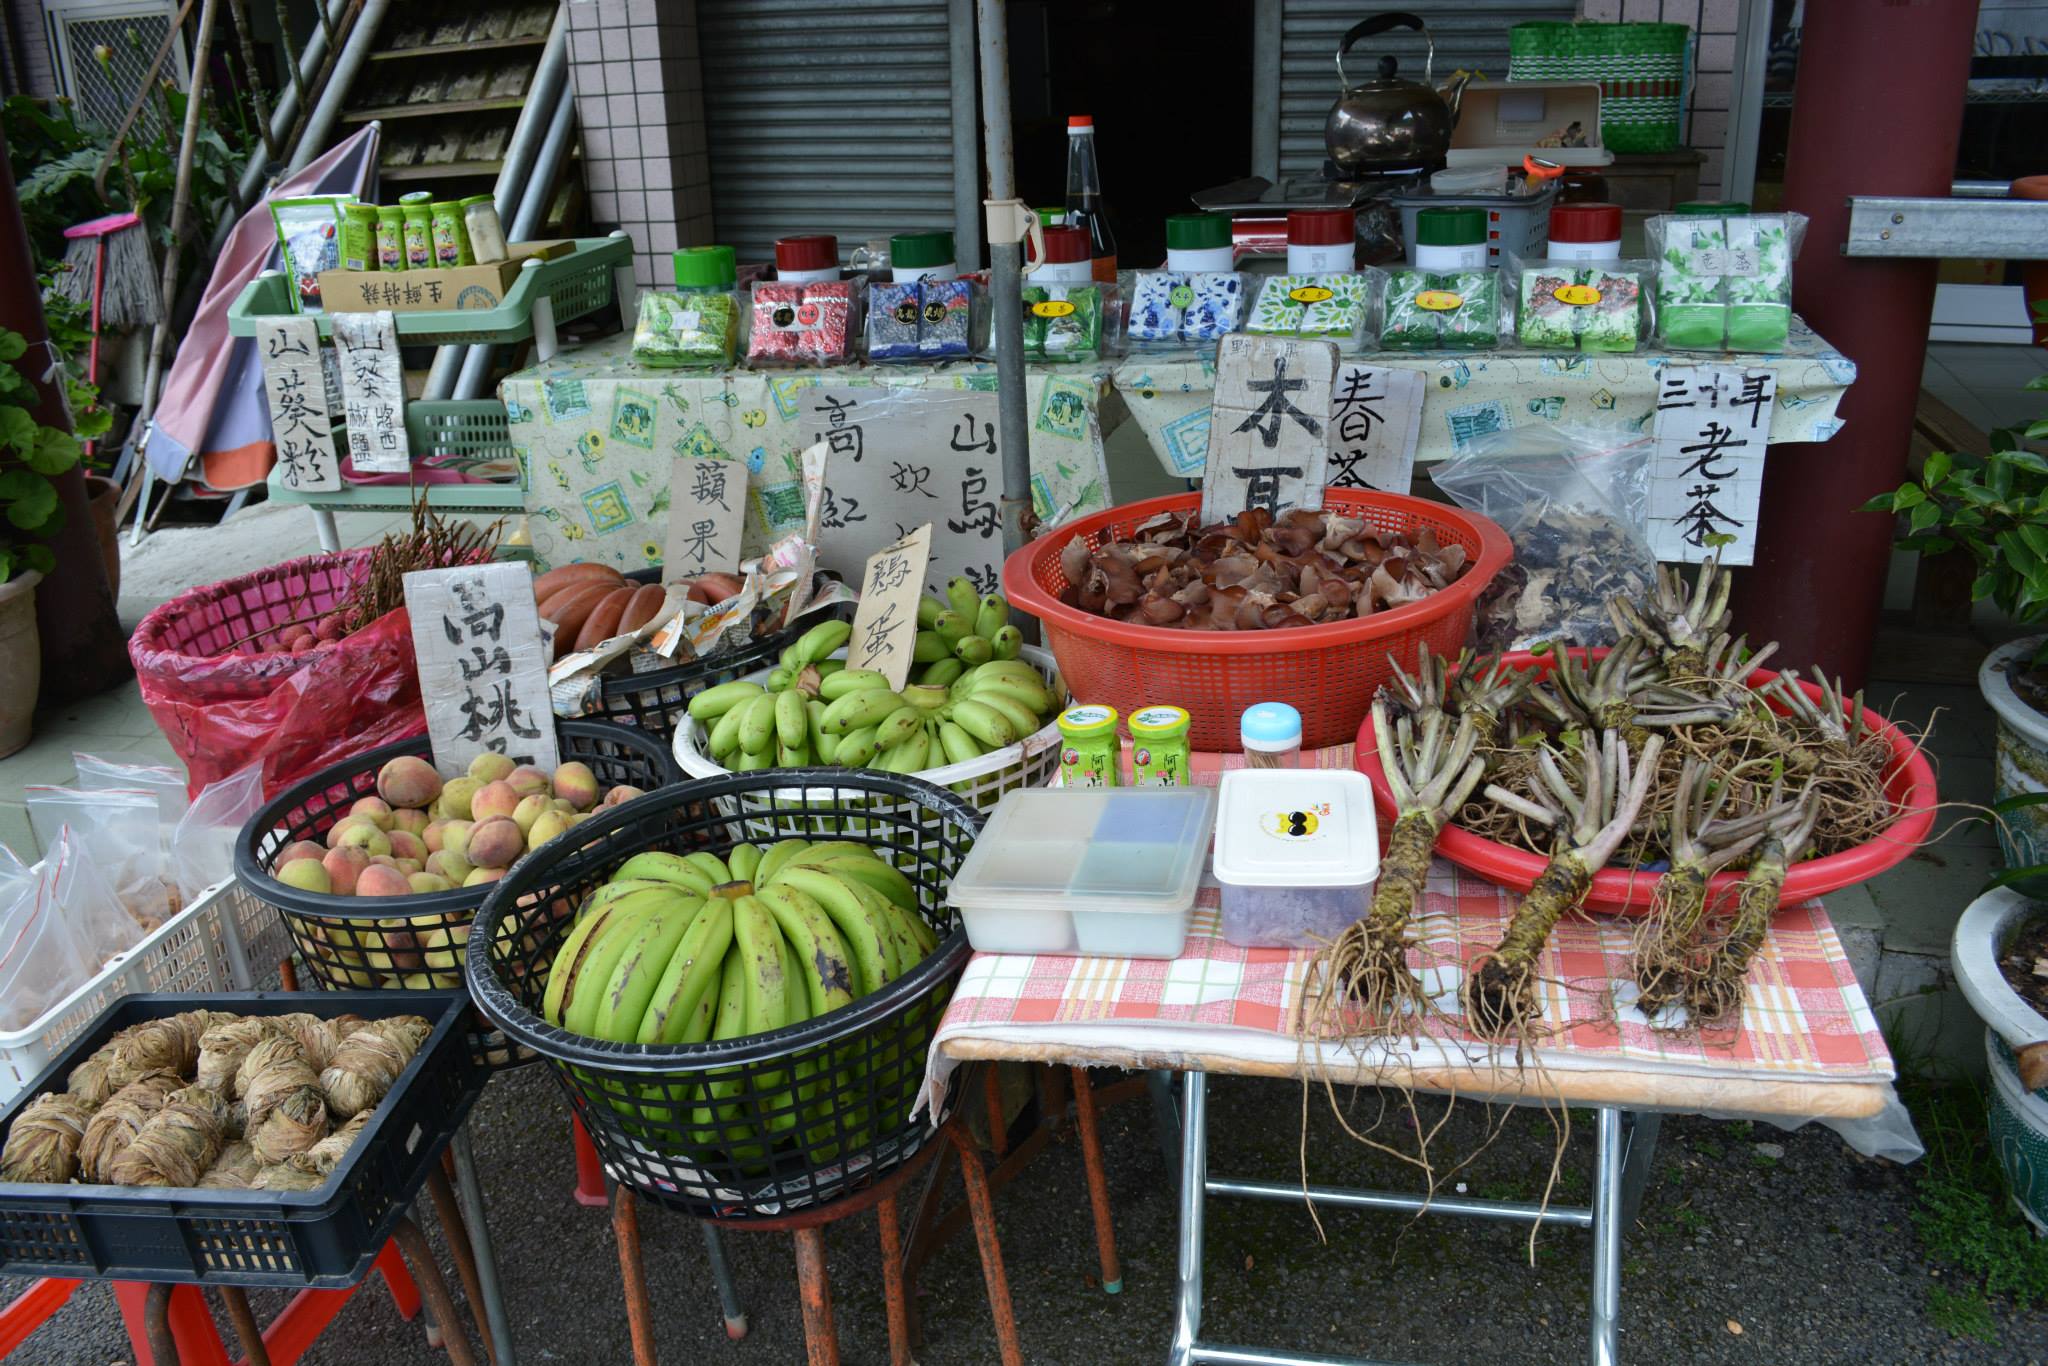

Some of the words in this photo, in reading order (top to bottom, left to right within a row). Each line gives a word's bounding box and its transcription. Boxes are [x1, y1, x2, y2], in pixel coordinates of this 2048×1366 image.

[1328, 368, 1385, 491] 春茶
[1657, 373, 1771, 428] 三十年
[683, 461, 731, 580] 蘋果
[1673, 422, 1748, 547] 老茶
